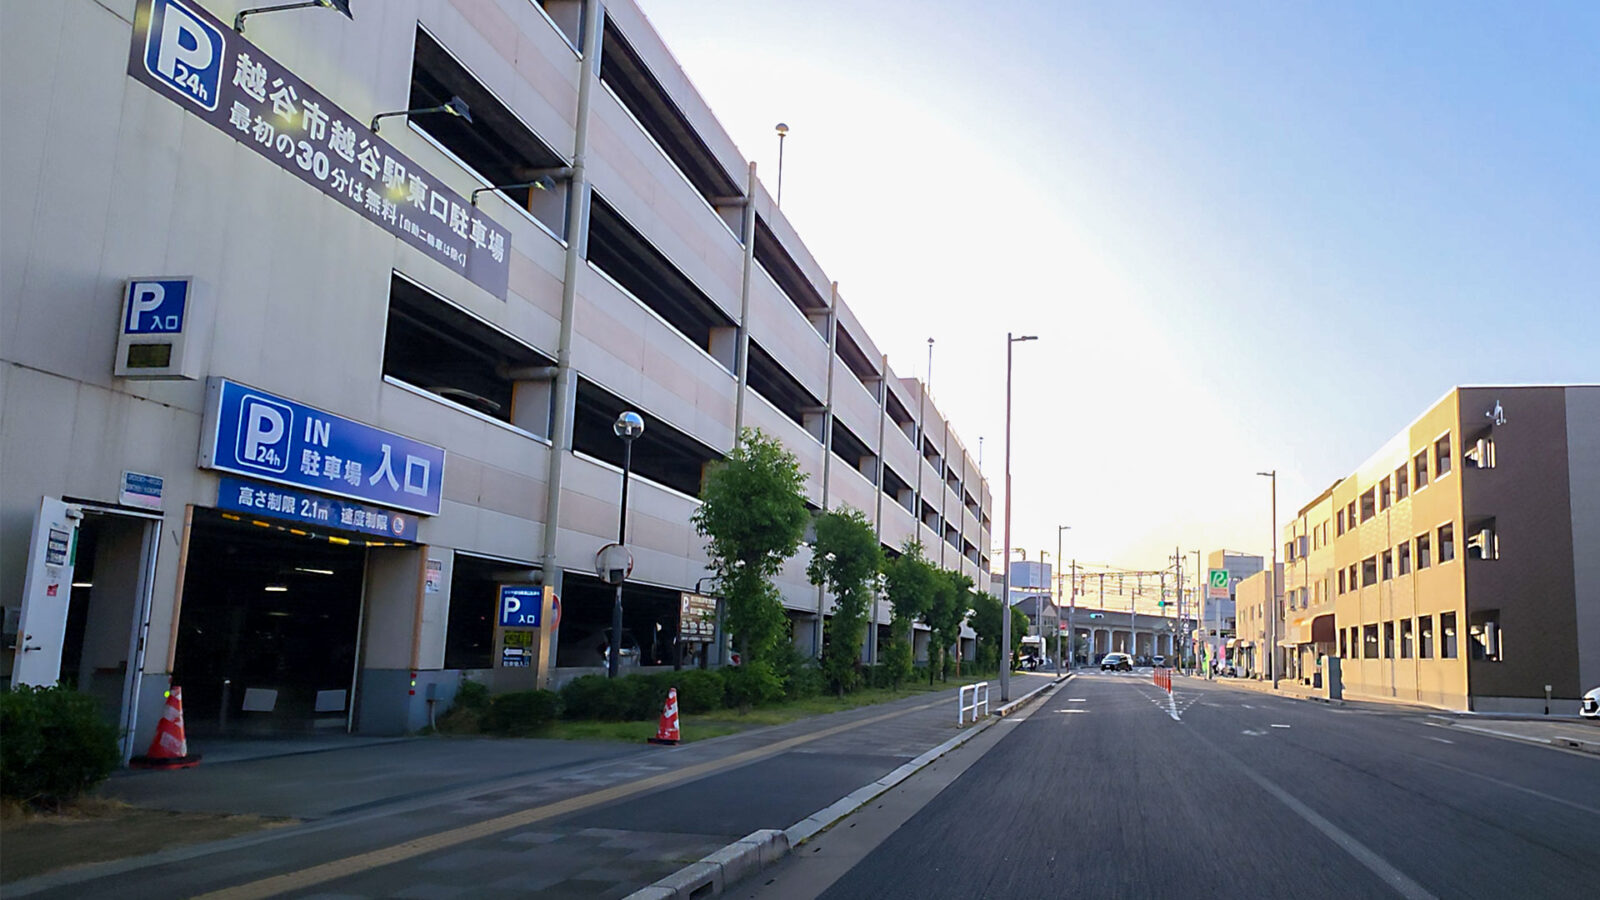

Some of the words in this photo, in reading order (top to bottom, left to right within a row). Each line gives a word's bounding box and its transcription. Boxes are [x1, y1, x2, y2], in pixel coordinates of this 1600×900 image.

[157, 3, 213, 80] P
[174, 64, 208, 101] 24h
[232, 53, 504, 263] 越谷市越谷駅東口駐車場
[129, 282, 165, 331] P
[150, 315, 178, 330] 入口
[244, 402, 284, 461] P
[304, 416, 331, 448] IN
[257, 446, 281, 467] 24h
[300, 449, 362, 487] 駐車場
[368, 443, 431, 497] 入口
[238, 486, 296, 514] 高さ制限
[300, 499, 328, 521] 2.1m
[340, 507, 389, 531] 速度制限
[503, 596, 521, 624] P
[518, 614, 535, 624] 入口
